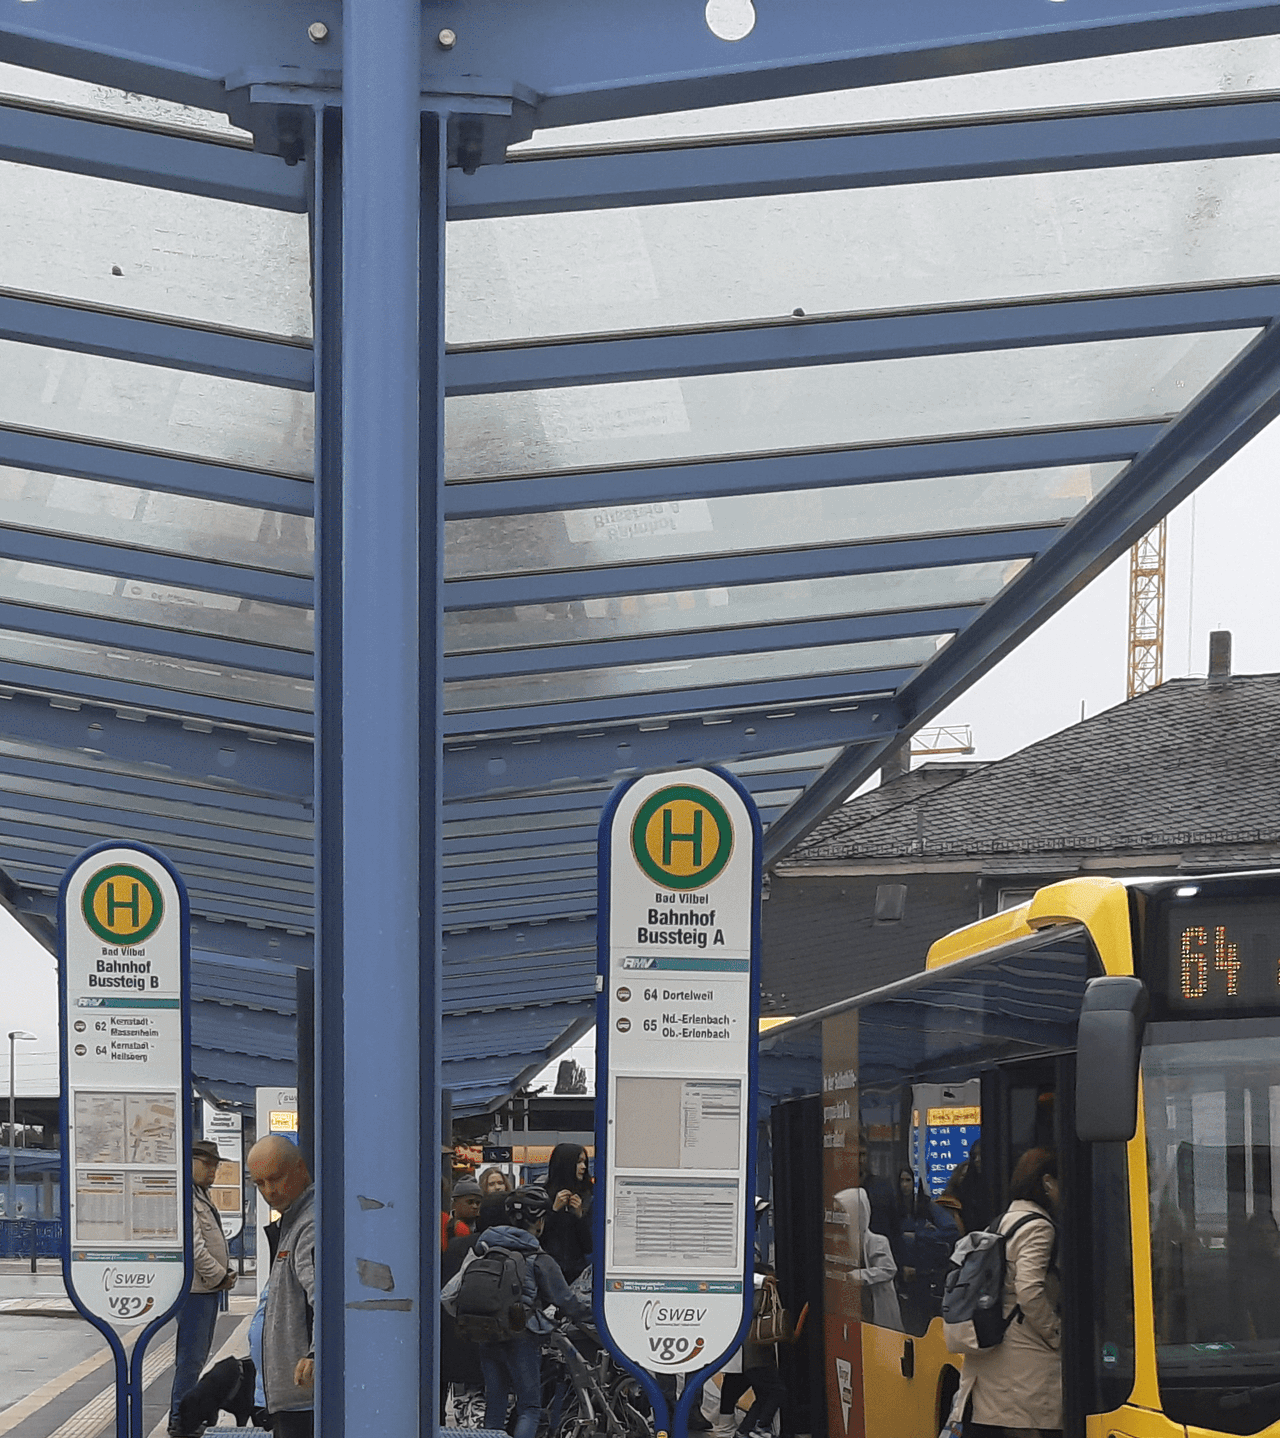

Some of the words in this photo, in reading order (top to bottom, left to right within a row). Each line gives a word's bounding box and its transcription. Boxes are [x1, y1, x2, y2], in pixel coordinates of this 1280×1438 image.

[662, 809, 702, 866] H
[107, 882, 139, 927] H
[655, 893, 676, 904] Bad
[679, 893, 709, 904] Vilbel
[648, 908, 716, 926] Bahnhof
[637, 927, 708, 948] Bussteig
[712, 929, 725, 945] A
[102, 947, 118, 956] Bad
[121, 947, 145, 957] Vilbel
[96, 959, 151, 974] Bahnhof
[1181, 925, 1241, 998] 64
[88, 974, 145, 990] Bussteig
[150, 976, 159, 988] B
[644, 989, 657, 1001] 64
[662, 990, 714, 1001] Dortelweil
[95, 1021, 107, 1031] 62
[643, 1019, 657, 1031] 65
[95, 1045, 107, 1055] 64
[114, 1273, 155, 1285] SWBV
[657, 1308, 707, 1321] SWBV
[649, 1337, 689, 1360] vgo
